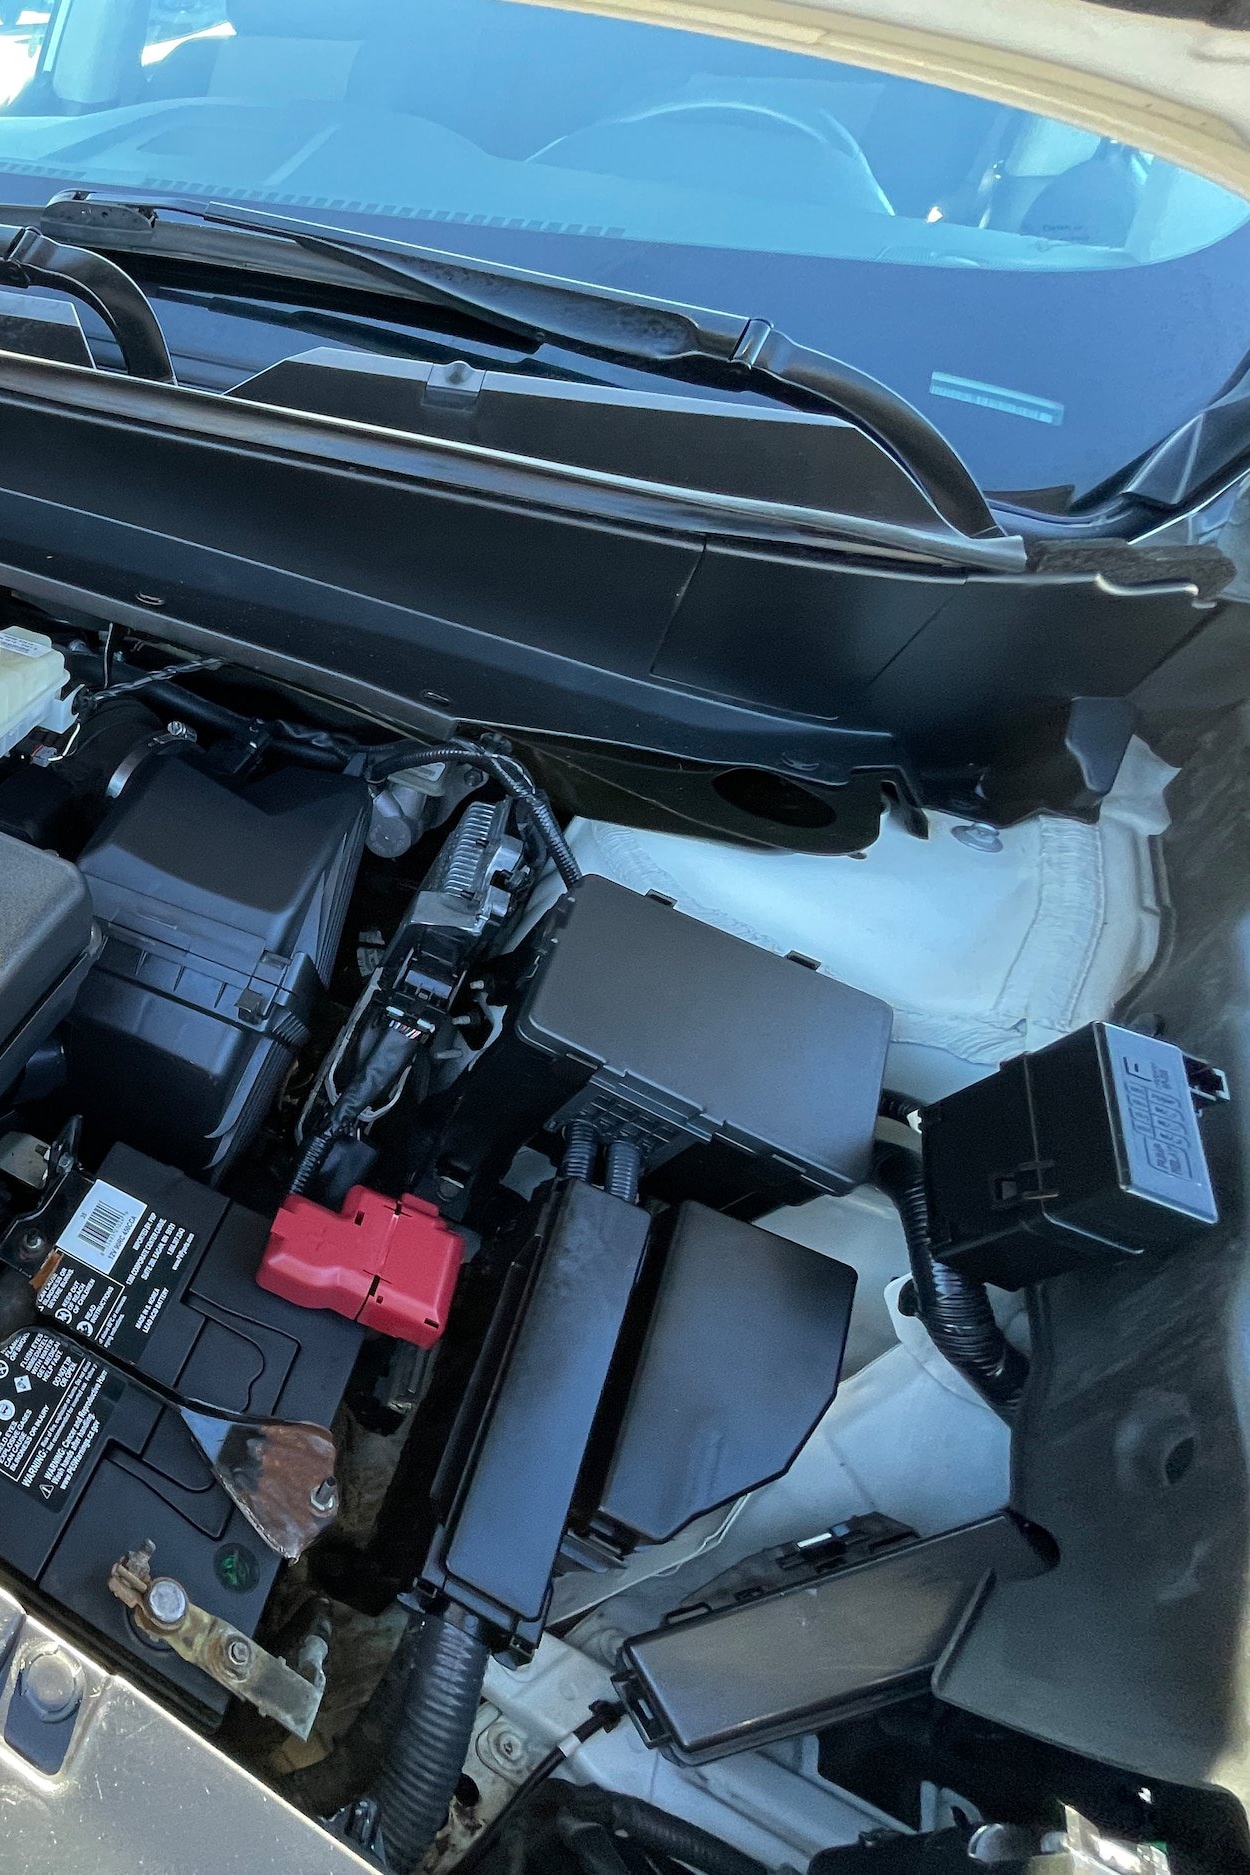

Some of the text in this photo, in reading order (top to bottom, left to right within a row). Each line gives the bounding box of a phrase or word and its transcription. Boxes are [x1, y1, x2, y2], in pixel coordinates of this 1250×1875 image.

[107, 1248, 117, 1260] 12V
[130, 1248, 150, 1276] CORPORATE
[144, 1231, 158, 1250] CENTER
[41, 1267, 67, 1306] BLINDNESS OR
[46, 1286, 63, 1309] SEVERE
[61, 1280, 80, 1307] KEEP OUT
[67, 1282, 86, 1311] OF REACH
[72, 1278, 95, 1314] OF CHILDREN
[147, 1287, 160, 1305] KOREA
[84, 1304, 96, 1320] READ
[89, 1285, 114, 1324] INSTRUCTIONS
[142, 1319, 153, 1333] LEAD
[154, 1287, 169, 1309] BATTERY
[9, 1350, 18, 1361] OR
[19, 1332, 43, 1368] FLUSH EYES
[30, 1338, 54, 1375] WITH WATER
[36, 1364, 46, 1378] GET
[41, 1364, 53, 1382] HELP
[52, 1356, 72, 1387] DO NOT TIP
[59, 1376, 69, 1387] OR
[77, 1382, 101, 1418] Reproductive
[16, 1408, 32, 1430] GASES
[73, 1415, 83, 1429] and
[3, 1431, 27, 1467] CAN CAUSE
[9, 1404, 49, 1472] BLINDNESS OR INJURY
[61, 1426, 77, 1448] Cancer
[21, 1448, 48, 1487] WARNING:
[43, 1447, 67, 1480] WARNING:
[50, 1467, 65, 1485] Wash
[59, 1449, 75, 1469] hands
[70, 1435, 81, 1451] after
